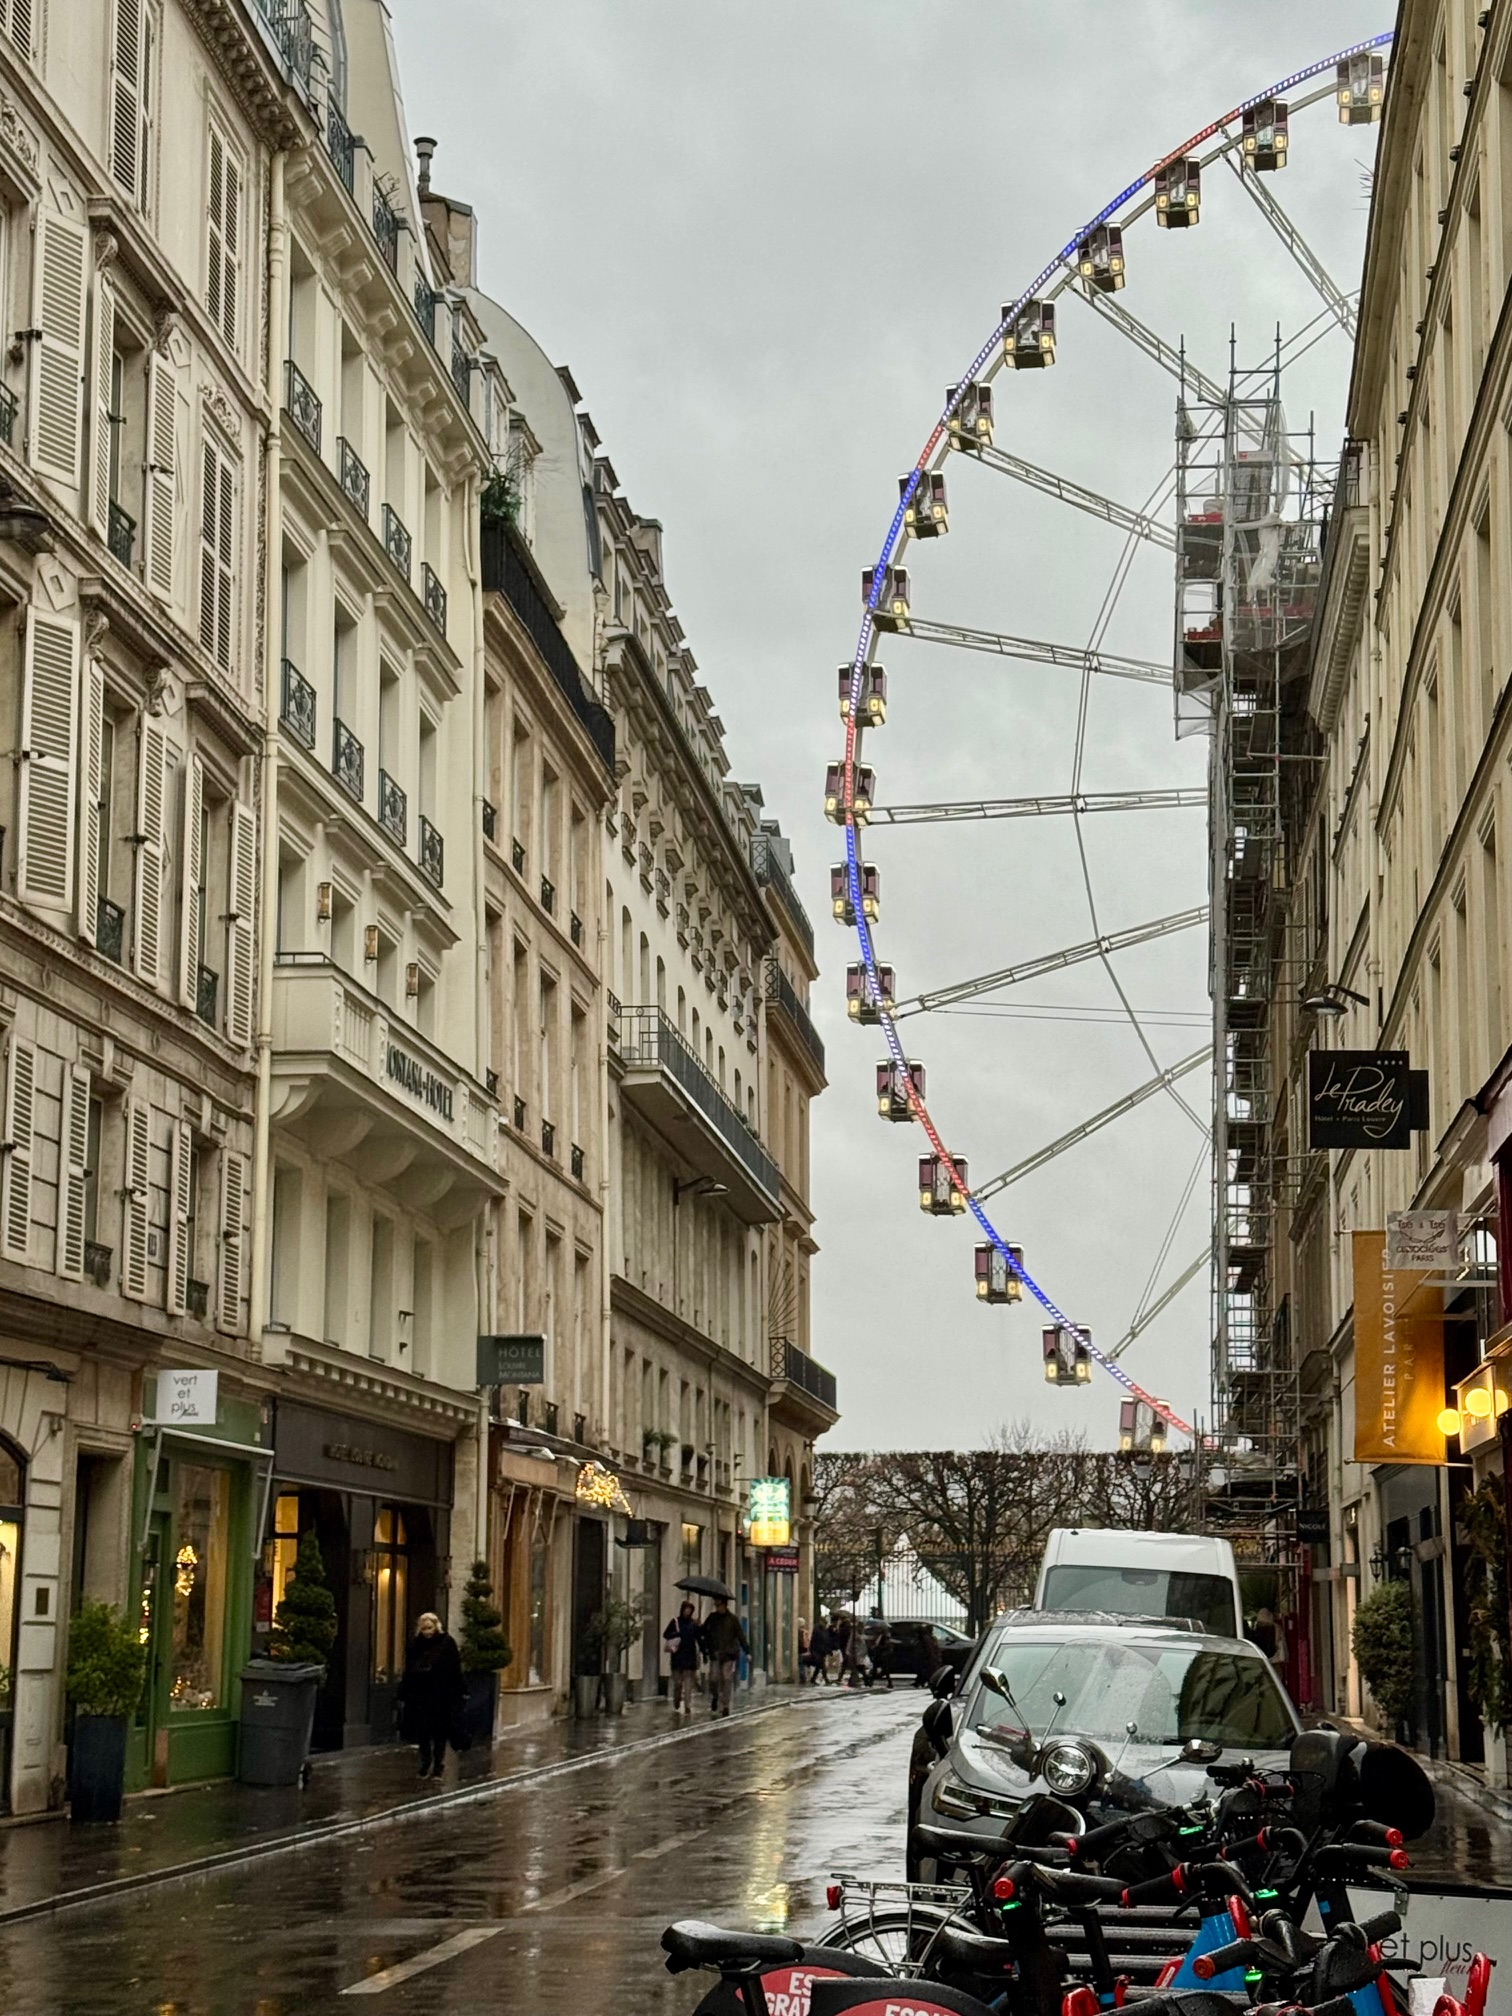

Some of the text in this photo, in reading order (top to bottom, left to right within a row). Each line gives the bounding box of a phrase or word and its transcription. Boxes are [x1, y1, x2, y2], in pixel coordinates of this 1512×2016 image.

[1314, 1061, 1404, 1138] Le Pradey
[1411, 1254, 1434, 1262] PARIS
[498, 1345, 541, 1358] HÔTEL
[173, 1374, 198, 1386] vert
[177, 1388, 191, 1399] et
[170, 1401, 197, 1415] plus
[1383, 1364, 1396, 1448] ATELIER
[1379, 1932, 1473, 1969] et plus
